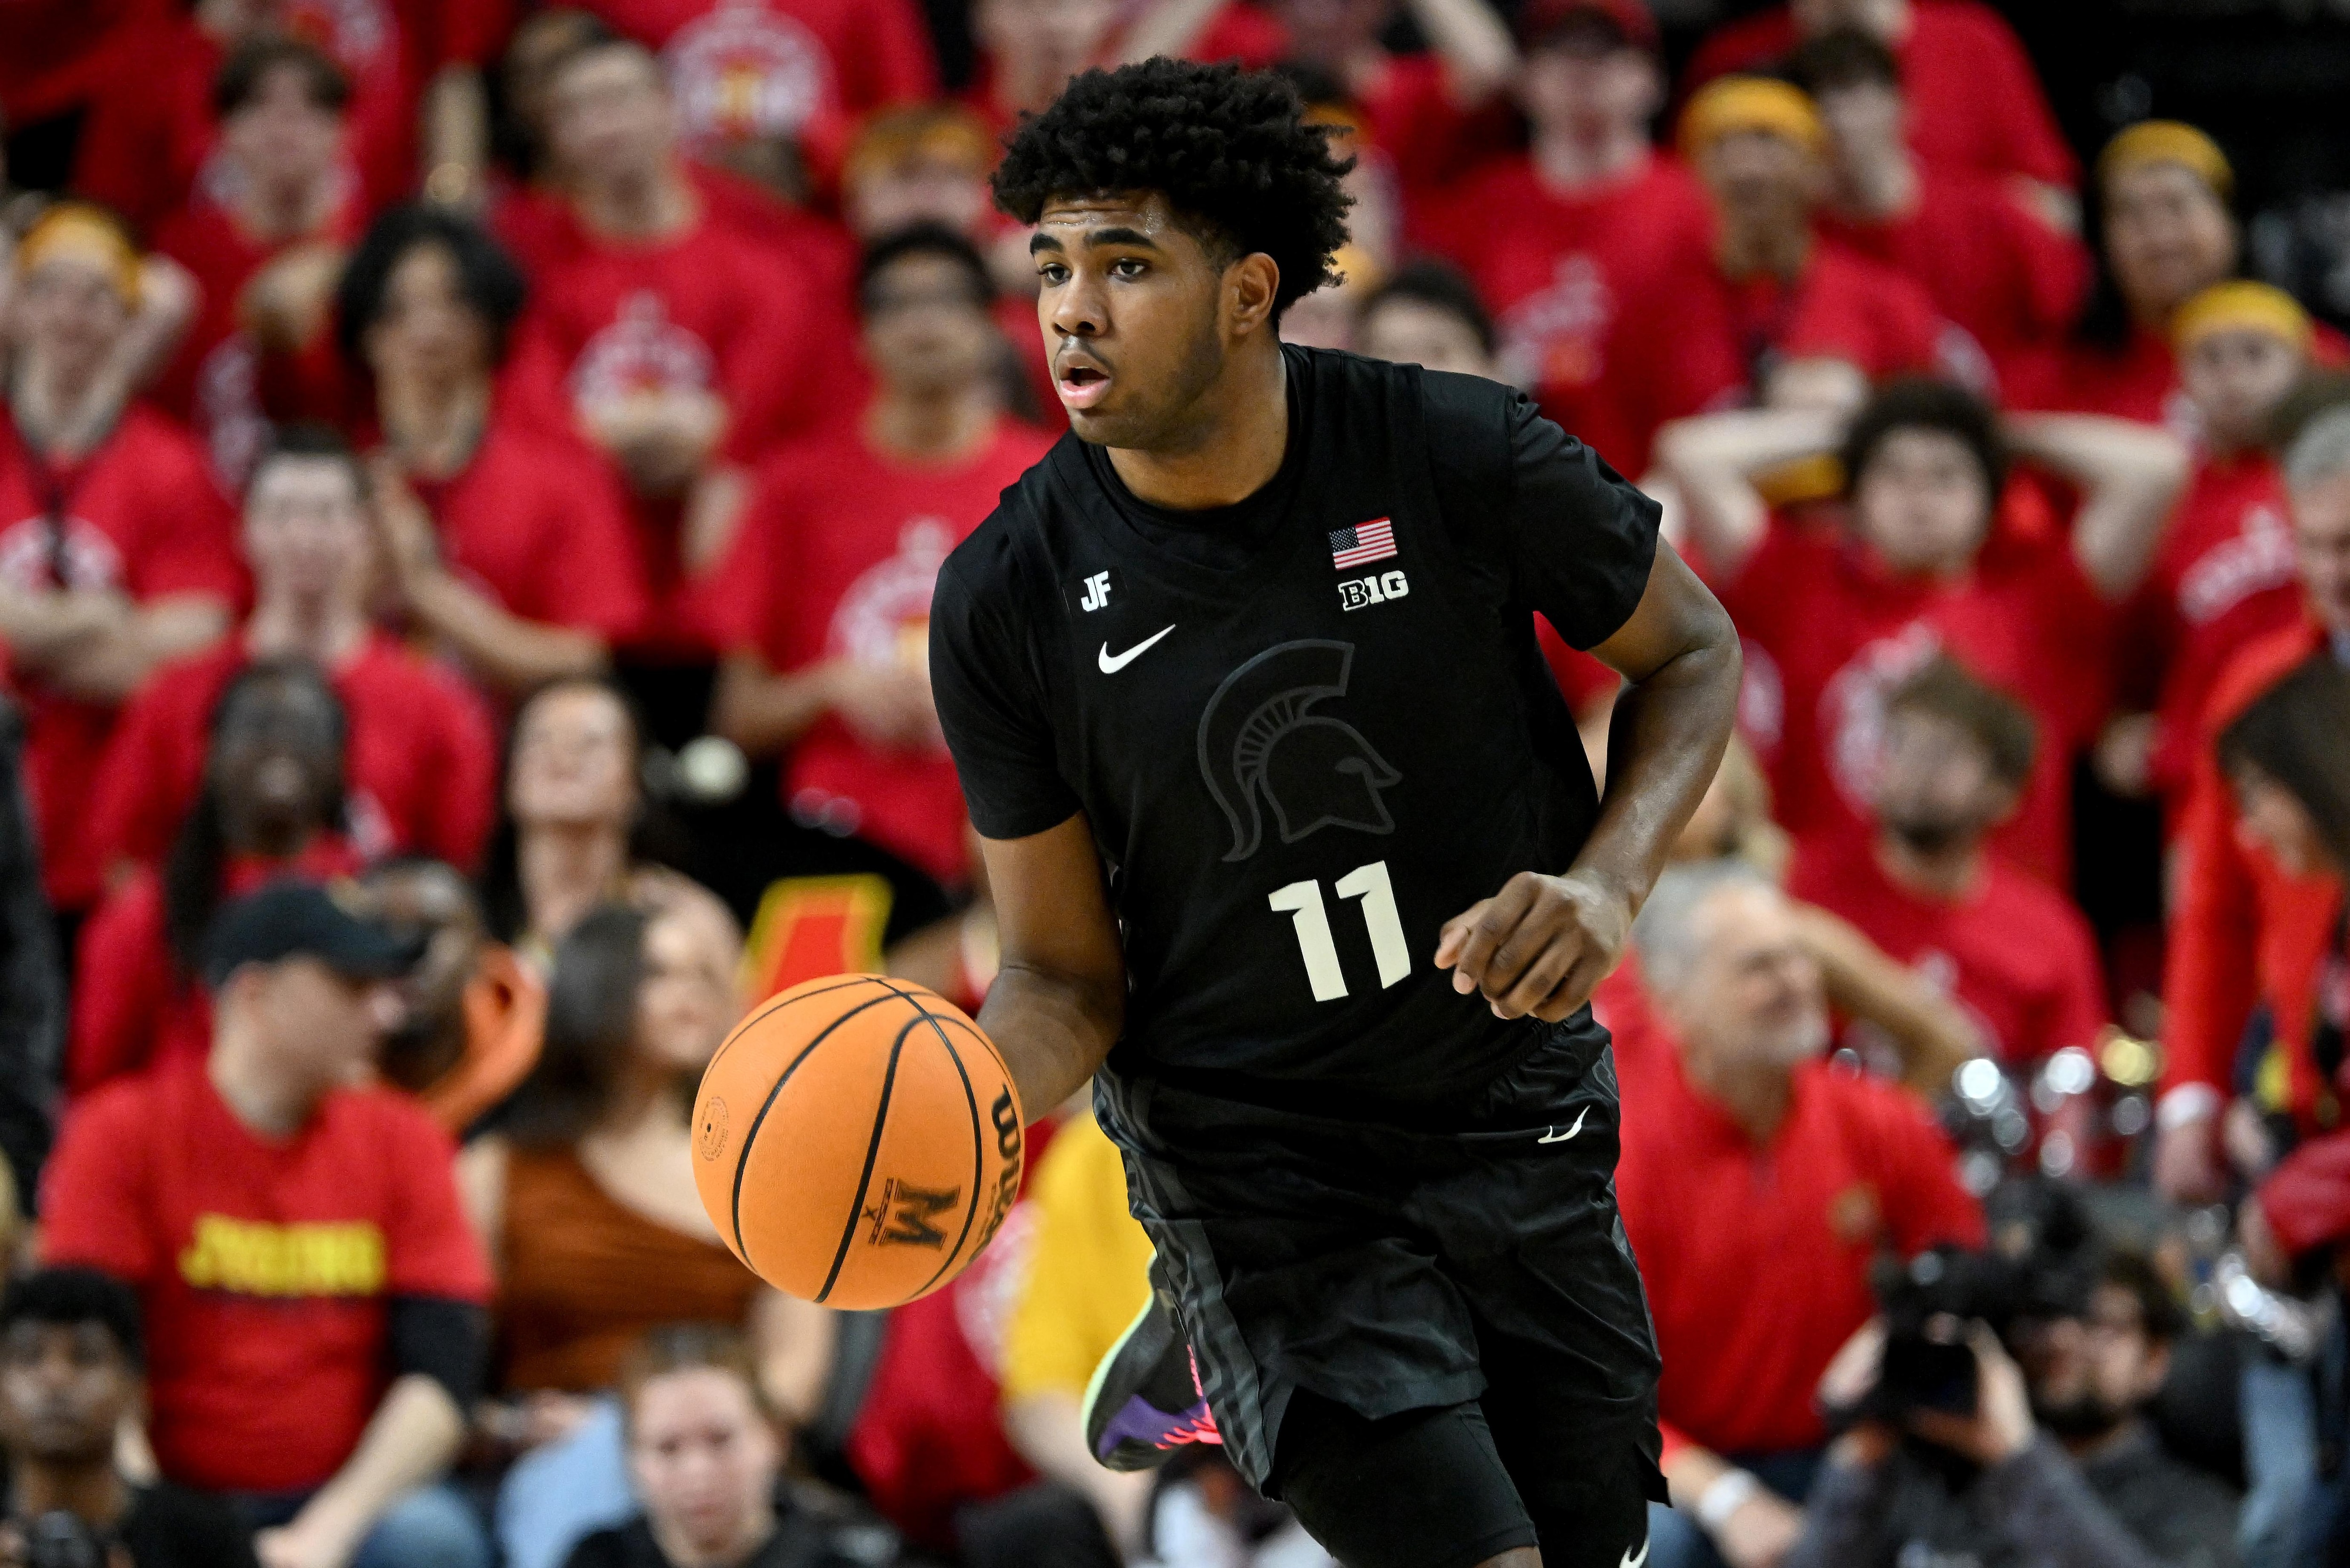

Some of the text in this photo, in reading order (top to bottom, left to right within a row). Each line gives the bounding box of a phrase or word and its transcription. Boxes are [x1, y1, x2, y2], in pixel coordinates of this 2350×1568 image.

[1081, 570, 1111, 612] JF
[1269, 860, 1410, 1001] 11
[878, 1179, 960, 1252] M
